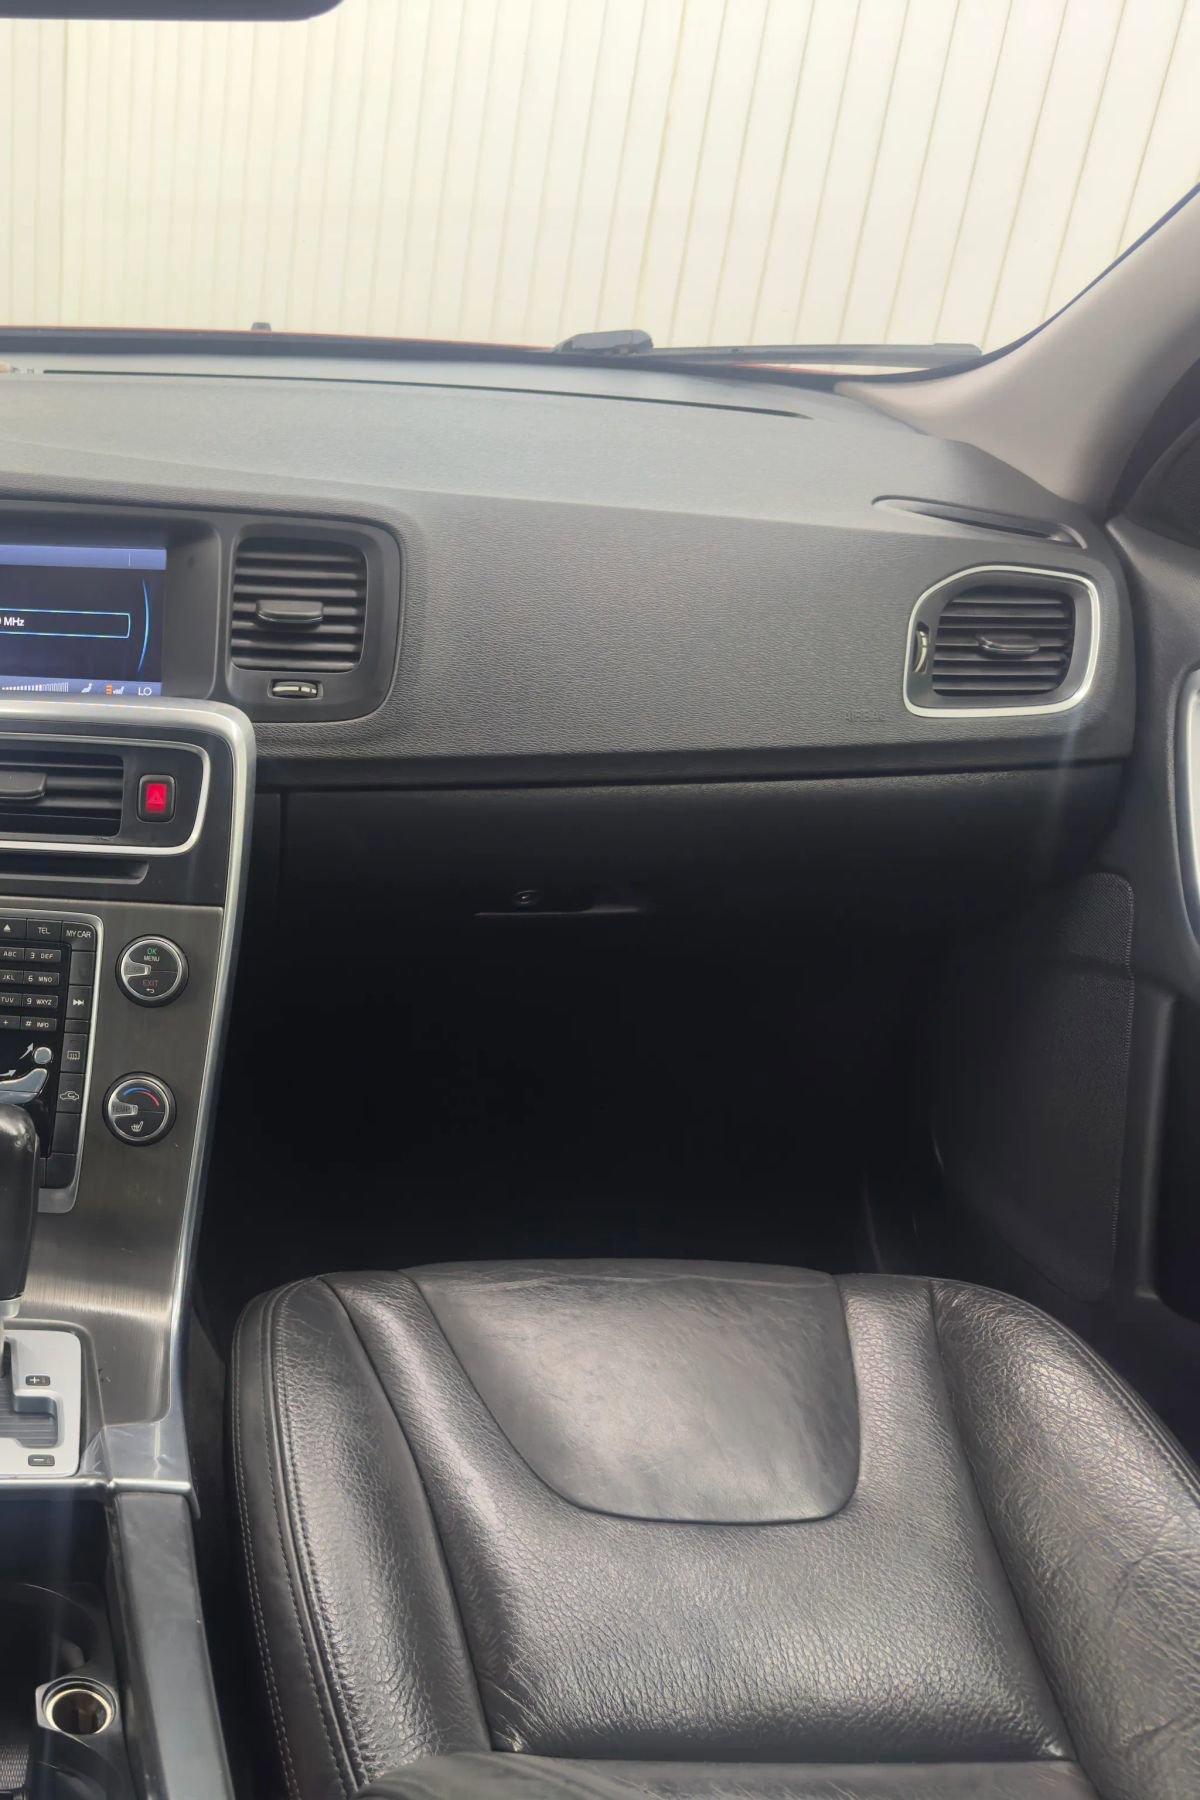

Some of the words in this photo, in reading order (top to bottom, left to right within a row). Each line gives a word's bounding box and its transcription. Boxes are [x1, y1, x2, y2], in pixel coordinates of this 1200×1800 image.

[3, 616, 25, 627] MHz
[137, 687, 152, 696] LO
[37, 927, 50, 935] TEL
